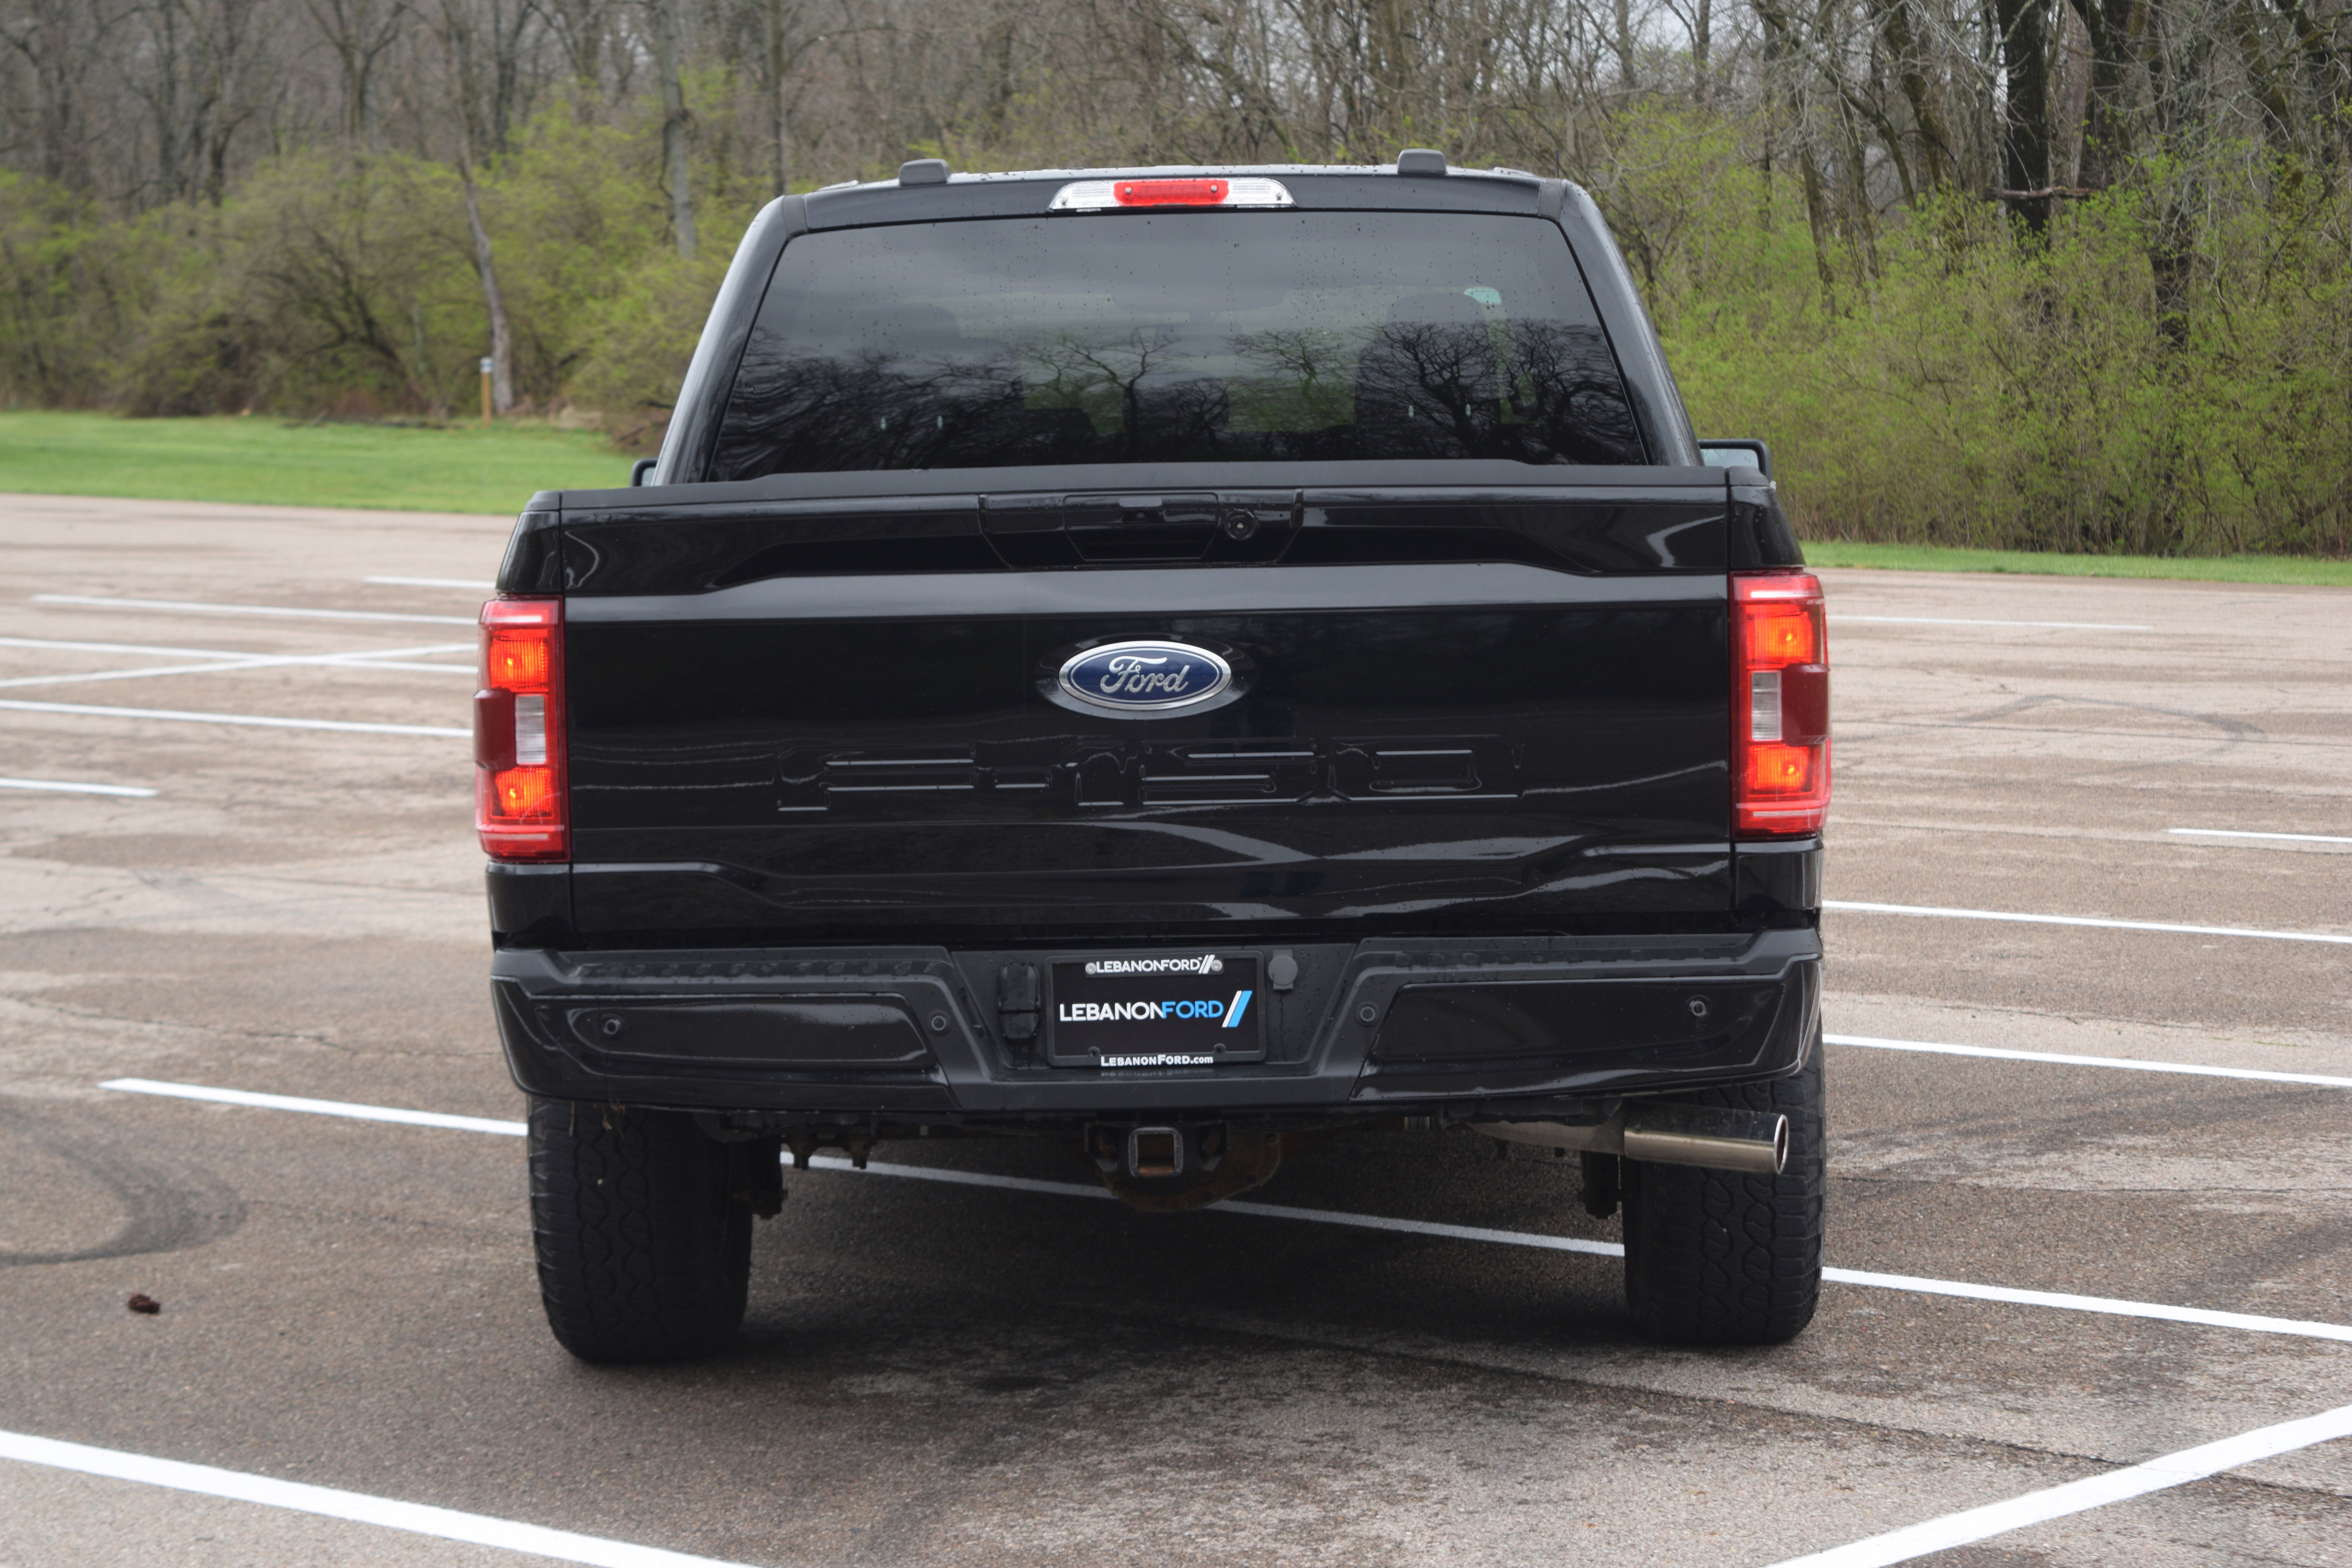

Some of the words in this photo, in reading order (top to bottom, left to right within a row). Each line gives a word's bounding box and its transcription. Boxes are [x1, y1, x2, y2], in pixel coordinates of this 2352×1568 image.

[1100, 656, 1189, 693] Ford
[776, 735, 1524, 811] F-150
[1060, 1000, 1223, 1021] LEBANONFORD
